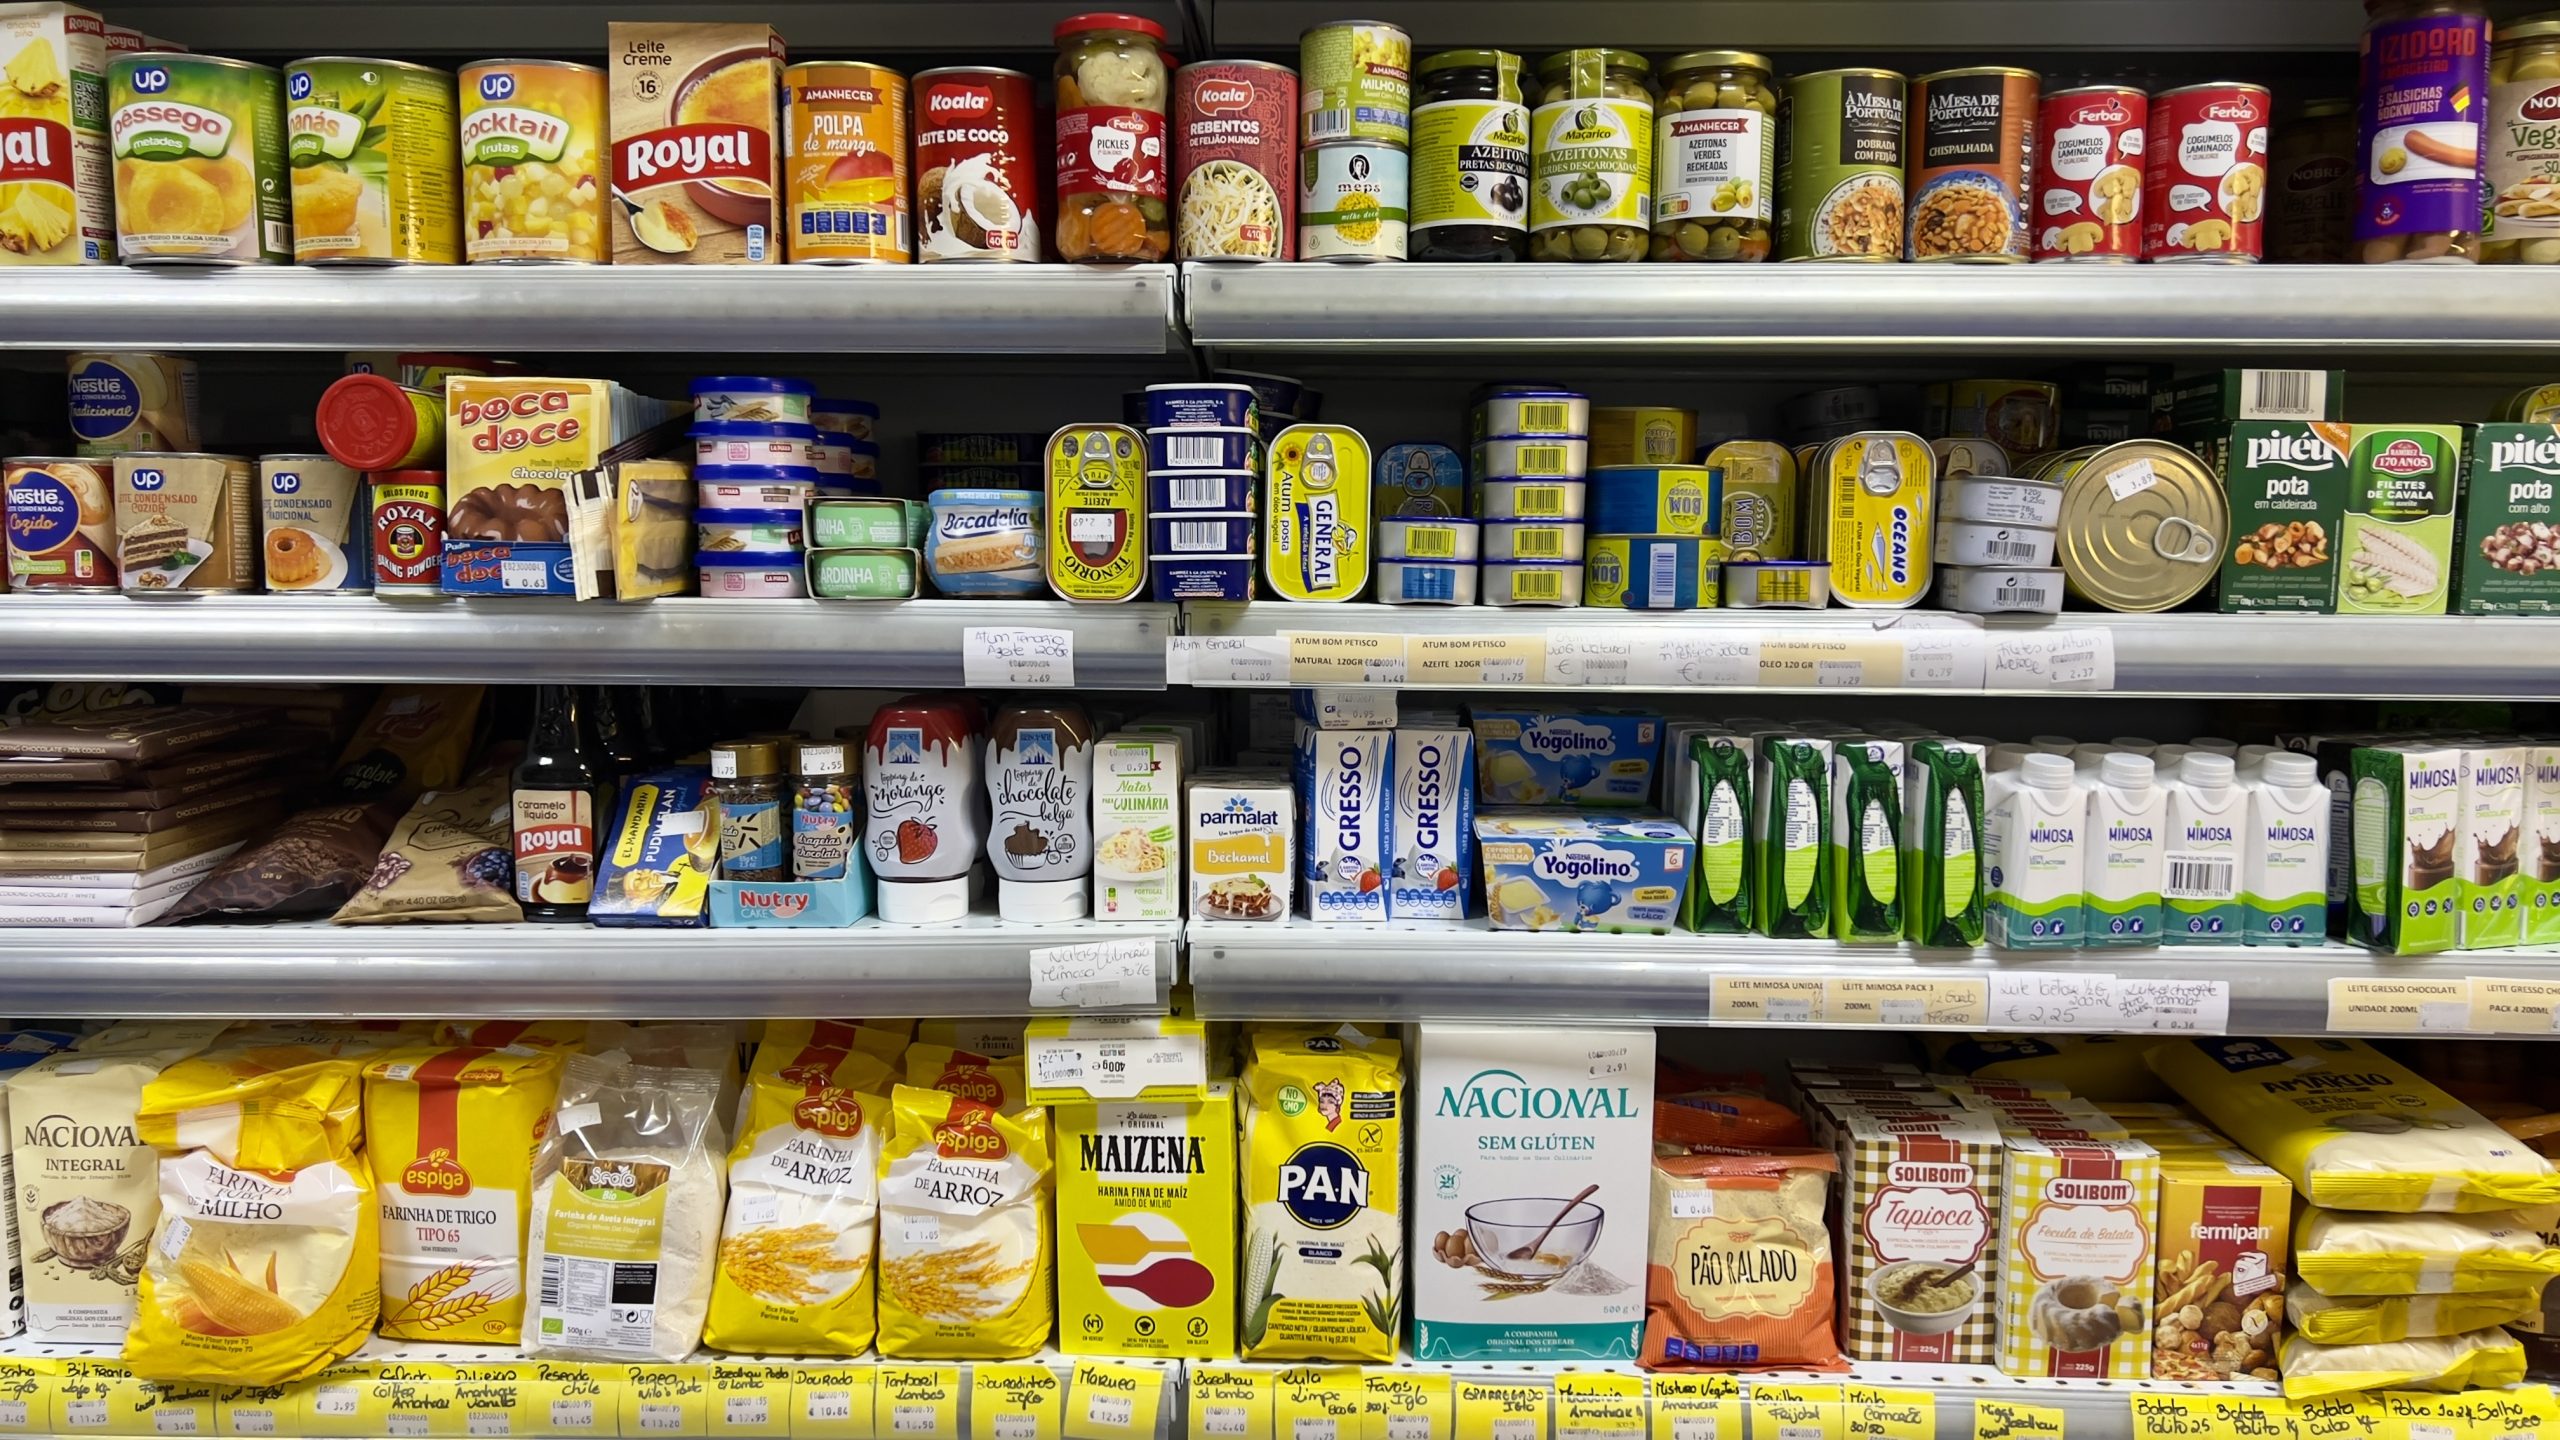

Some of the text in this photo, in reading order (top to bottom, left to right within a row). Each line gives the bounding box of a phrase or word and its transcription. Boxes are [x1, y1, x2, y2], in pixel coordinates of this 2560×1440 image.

[629, 41, 664, 53] Leite
[623, 53, 672, 66] Creme
[135, 70, 166, 90] up
[640, 80, 655, 94] 16
[806, 89, 873, 102] AMANHECER
[930, 92, 984, 110] Koala
[1202, 88, 1245, 103] Koala
[1940, 94, 1977, 107] MESA
[1981, 95, 1999, 106] DE
[1929, 107, 1999, 122] PORTUGAL
[2079, 110, 2123, 122] Ferbar
[113, 107, 222, 142] pêssego
[462, 112, 558, 146] cocktail
[814, 115, 864, 136] POLPA
[1190, 120, 1260, 135] REBENTOS
[1679, 122, 1739, 135] AMANHECER
[1190, 134, 1260, 146] DE FEIJÃO MUNGO
[1566, 128, 1611, 141] Maçarico
[2187, 134, 2233, 144] COGUMELOS
[482, 142, 519, 155] frutas
[1097, 138, 1129, 150] PICKLES
[1689, 138, 1727, 149] AZEITONAS
[1857, 139, 1895, 150] DOBRADA
[2059, 138, 2103, 149] COGUMELOS
[2186, 144, 2233, 154] LAMINADOS
[627, 130, 751, 181] Royal
[1548, 148, 1627, 161] AZEITONAS
[1694, 150, 1721, 160] VERDES
[1929, 144, 1993, 156] CHISPALHADA
[2058, 147, 2103, 158] LAMINADOS
[1855, 151, 1896, 163] COM FEIJÃO
[1460, 160, 1494, 170] PRETAS
[1686, 161, 1728, 172] RECHEADAS
[1338, 183, 1381, 193] meps
[2246, 429, 2333, 469] pitéu
[2378, 457, 2428, 467] 170 ANOS
[2266, 476, 2309, 499] pota
[2377, 481, 2426, 490] FILETES
[2510, 480, 2552, 502] pota
[2368, 490, 2434, 500] DE CAVALA
[1084, 498, 1112, 506] AZEITE
[2254, 499, 2317, 510] em caldeirada
[2508, 502, 2550, 513] com alho
[1281, 471, 1293, 552] Atum posta
[377, 504, 438, 533] ROYAL
[1314, 500, 1332, 583] GENERAL
[1892, 507, 1907, 584] OCEANO
[522, 578, 546, 588] 0.63
[1295, 637, 1378, 647] ATUM BOM PETISCO
[1422, 640, 1506, 648] ATUM BOM PETISCO
[1294, 657, 1363, 666] NATURAL 120GR
[1422, 660, 1481, 668] AZEITE 120GR
[1760, 660, 1813, 669] OLEO 120 GR
[1501, 673, 1524, 681] 1.75
[2070, 668, 2094, 679] 2.37
[1529, 731, 1607, 753] Yogolino
[1338, 746, 1362, 851] GRESSO
[1416, 745, 1440, 849] GRESSO
[517, 800, 566, 812] Caramelo
[1200, 811, 1278, 828] parmalat
[520, 827, 582, 852] Royal
[2030, 828, 2074, 843] MIMOSA
[2109, 827, 2152, 841] MIMOSA
[2187, 827, 2232, 841] MIMOSA
[1485, 852, 1529, 861] BAUNILHA
[1543, 855, 1630, 879] Yogolino
[739, 890, 809, 912] Nutry
[740, 909, 769, 919] CAKE
[1730, 981, 1790, 990] LEITE MIMOSA
[1842, 982, 1934, 992] LEITE MIMOSA PACK 3
[2348, 985, 2369, 993] LEITE
[2407, 986, 2456, 994] CHOCOLATE
[2486, 984, 2508, 992] LEITE
[1732, 1000, 1759, 1008] 200ML
[1844, 1002, 1872, 1010] 200ML
[2521, 1006, 2549, 1014] 200ML
[1285, 1088, 1299, 1099] NO
[1435, 1069, 1639, 1119] NACIONAL
[1282, 1101, 1299, 1111] GMO
[1478, 1133, 1595, 1151] SEM GLÚTEN
[1080, 1134, 1206, 1174] MAIZENA
[46, 1159, 125, 1171] INTEGRAL
[407, 1170, 464, 1189] espiga
[1894, 1166, 1968, 1183] SOLIBOM
[602, 1189, 617, 1200] Bio
[1098, 1185, 1188, 1199] HARINA FINA DE MAÍZ
[2054, 1183, 2127, 1200] SOLIBOM
[1114, 1198, 1172, 1209] AMIDO DE MILHO
[200, 1200, 282, 1220] MILHO
[383, 1205, 496, 1225] FARINHA DE TRIGO
[1885, 1200, 1974, 1231] Tapioca
[554, 1209, 656, 1226] Farinha de Aveia Integral
[416, 1227, 460, 1243] TIPO 65
[2038, 1225, 2135, 1240] Fécula de Batata
[2190, 1223, 2269, 1244] fermipan
[567, 1326, 584, 1336] 500g
[1487, 1338, 1522, 1346] ORIGINAL
[2075, 1363, 2094, 1372] 225g
